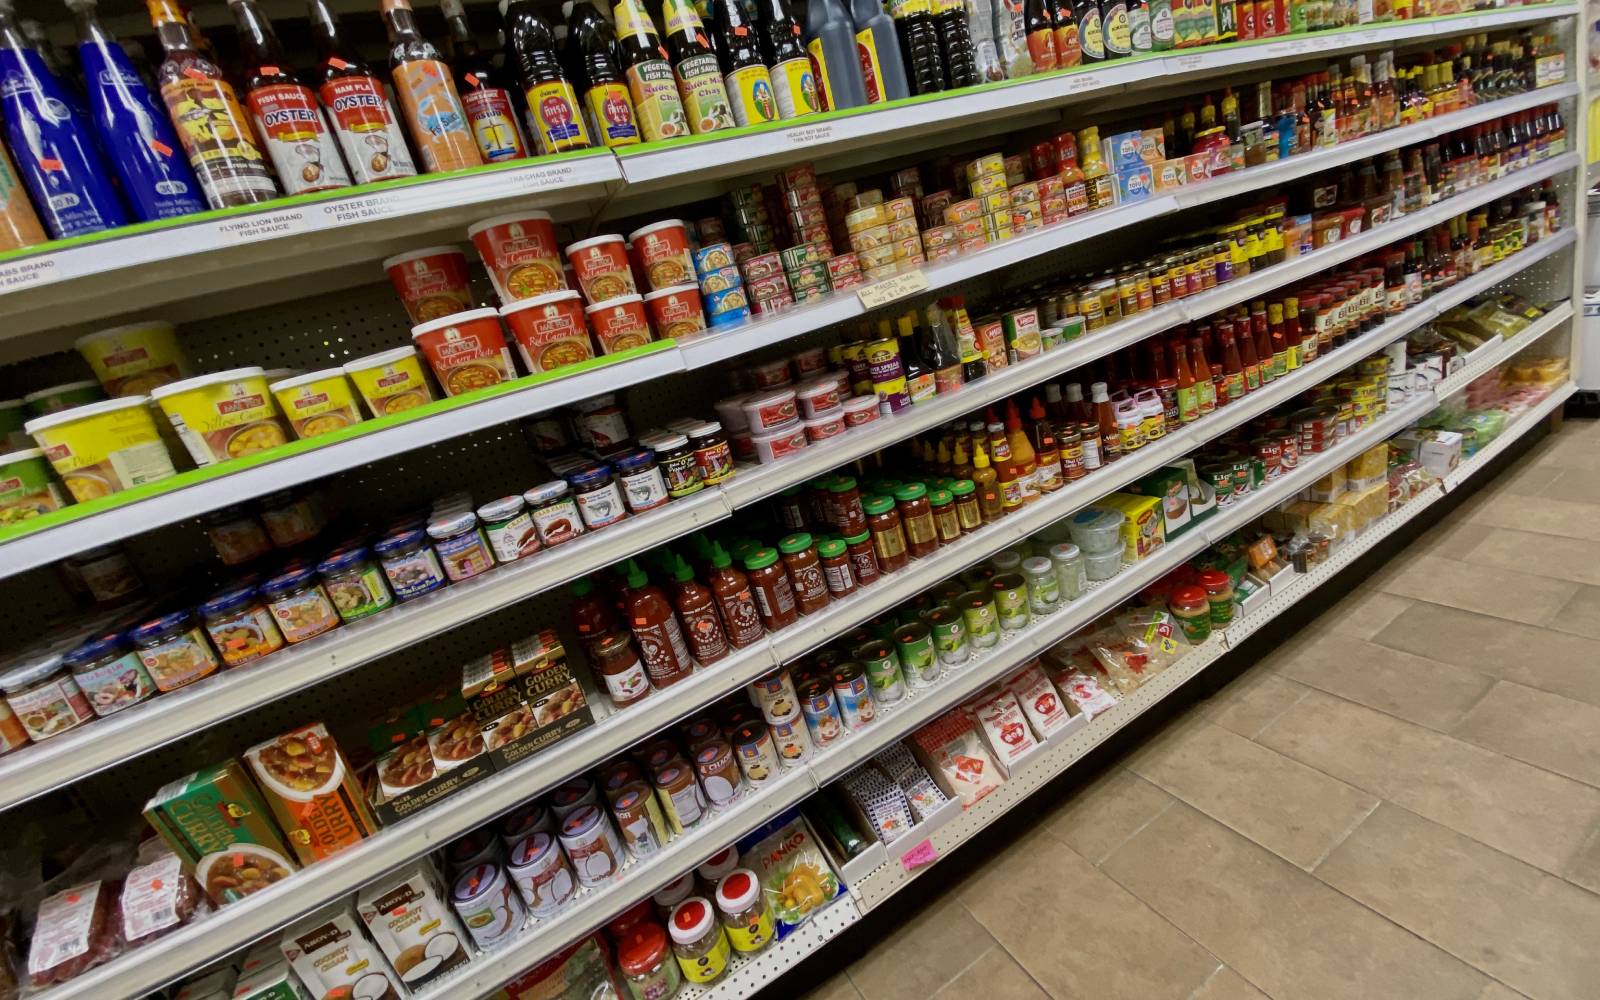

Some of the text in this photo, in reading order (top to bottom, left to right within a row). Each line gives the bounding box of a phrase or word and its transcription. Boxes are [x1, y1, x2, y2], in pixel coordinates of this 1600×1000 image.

[645, 71, 661, 80] FISH
[685, 69, 699, 79] FISH
[355, 82, 372, 92] PLA
[257, 94, 276, 105] FISH
[334, 94, 382, 113] OYSTER
[265, 109, 318, 127] OYSTER
[323, 201, 364, 215] OYSTER
[219, 213, 303, 233] FLYING LION BRAND
[336, 212, 360, 222] FISH
[239, 223, 290, 237] FISH SAUCE
[20, 260, 55, 273] BRAND
[7, 272, 39, 284] SAUCE
[448, 353, 471, 367] Curry
[525, 662, 568, 687] GOLDEN
[526, 671, 573, 697] CURRY
[504, 727, 563, 761] GOLDEN CURRY
[394, 776, 460, 814] GOLDEN CURRY
[761, 832, 806, 871] PANKO
